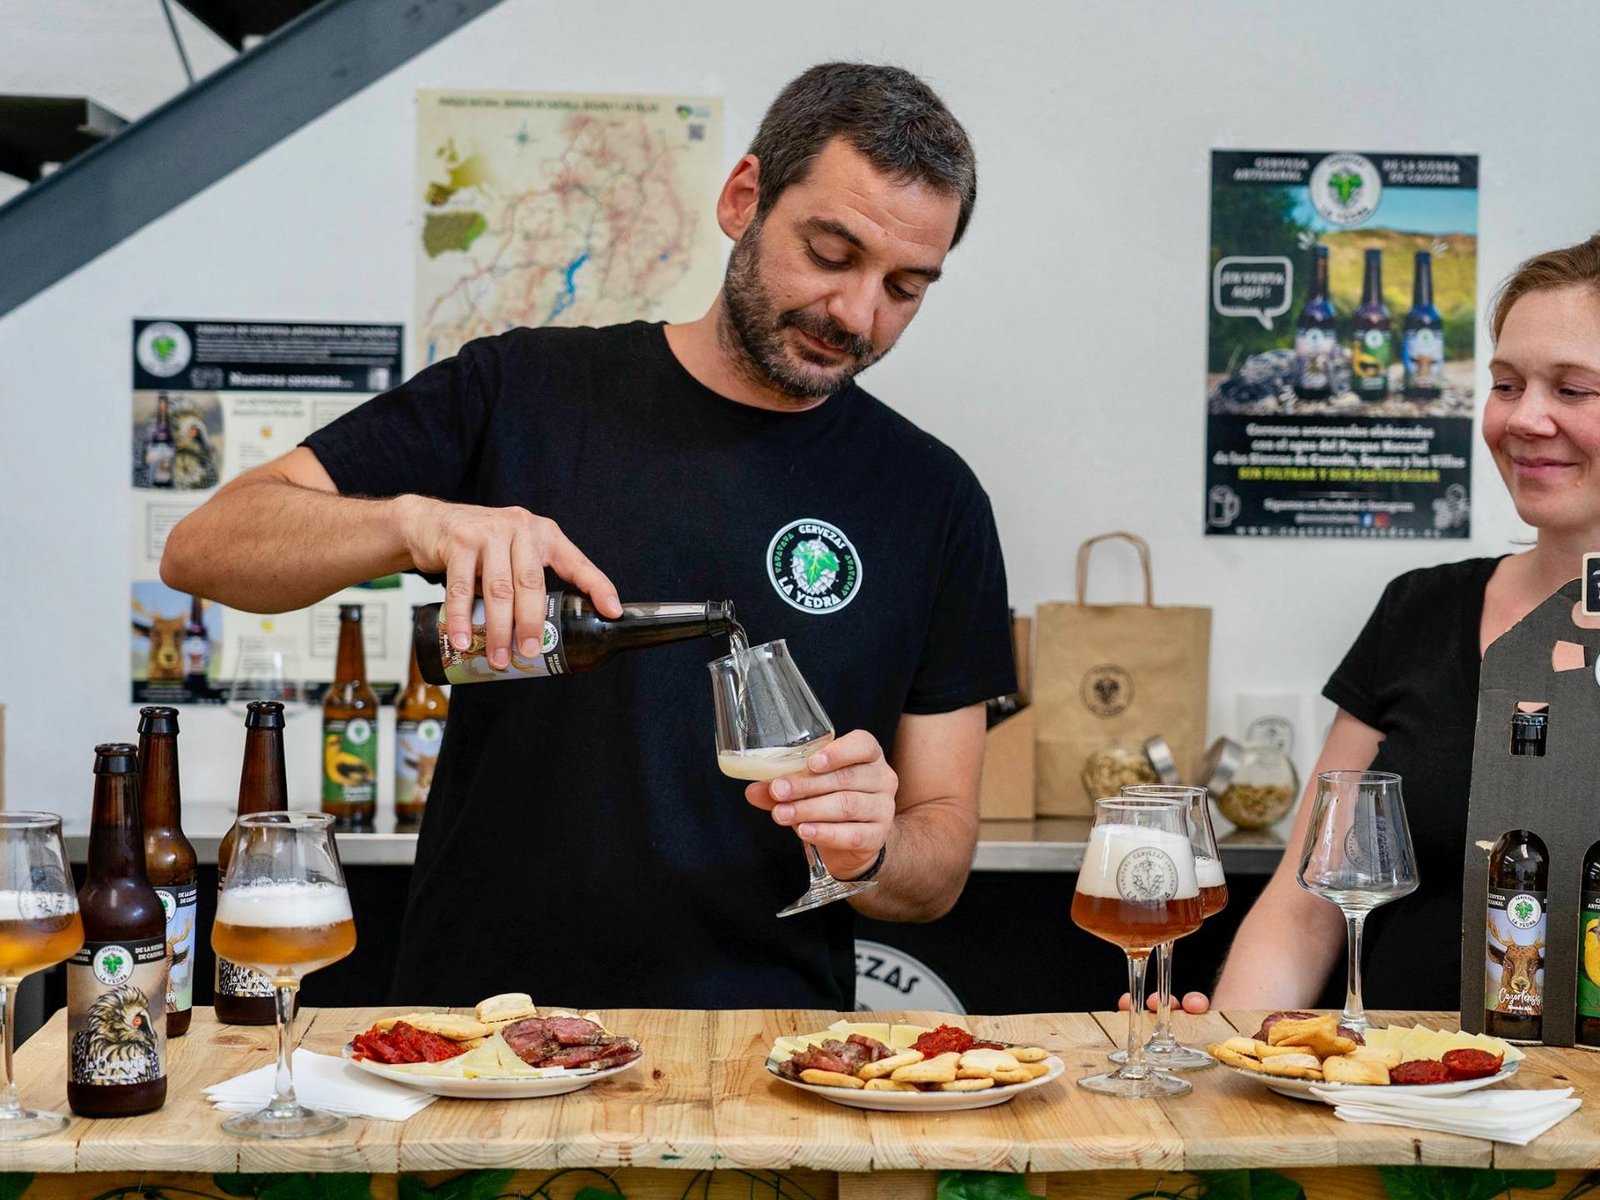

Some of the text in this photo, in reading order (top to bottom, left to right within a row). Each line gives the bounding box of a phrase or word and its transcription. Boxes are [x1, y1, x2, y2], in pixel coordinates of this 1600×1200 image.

[798, 524, 846, 550] CERVEZAS
[778, 576, 842, 608] LA YEDRA
